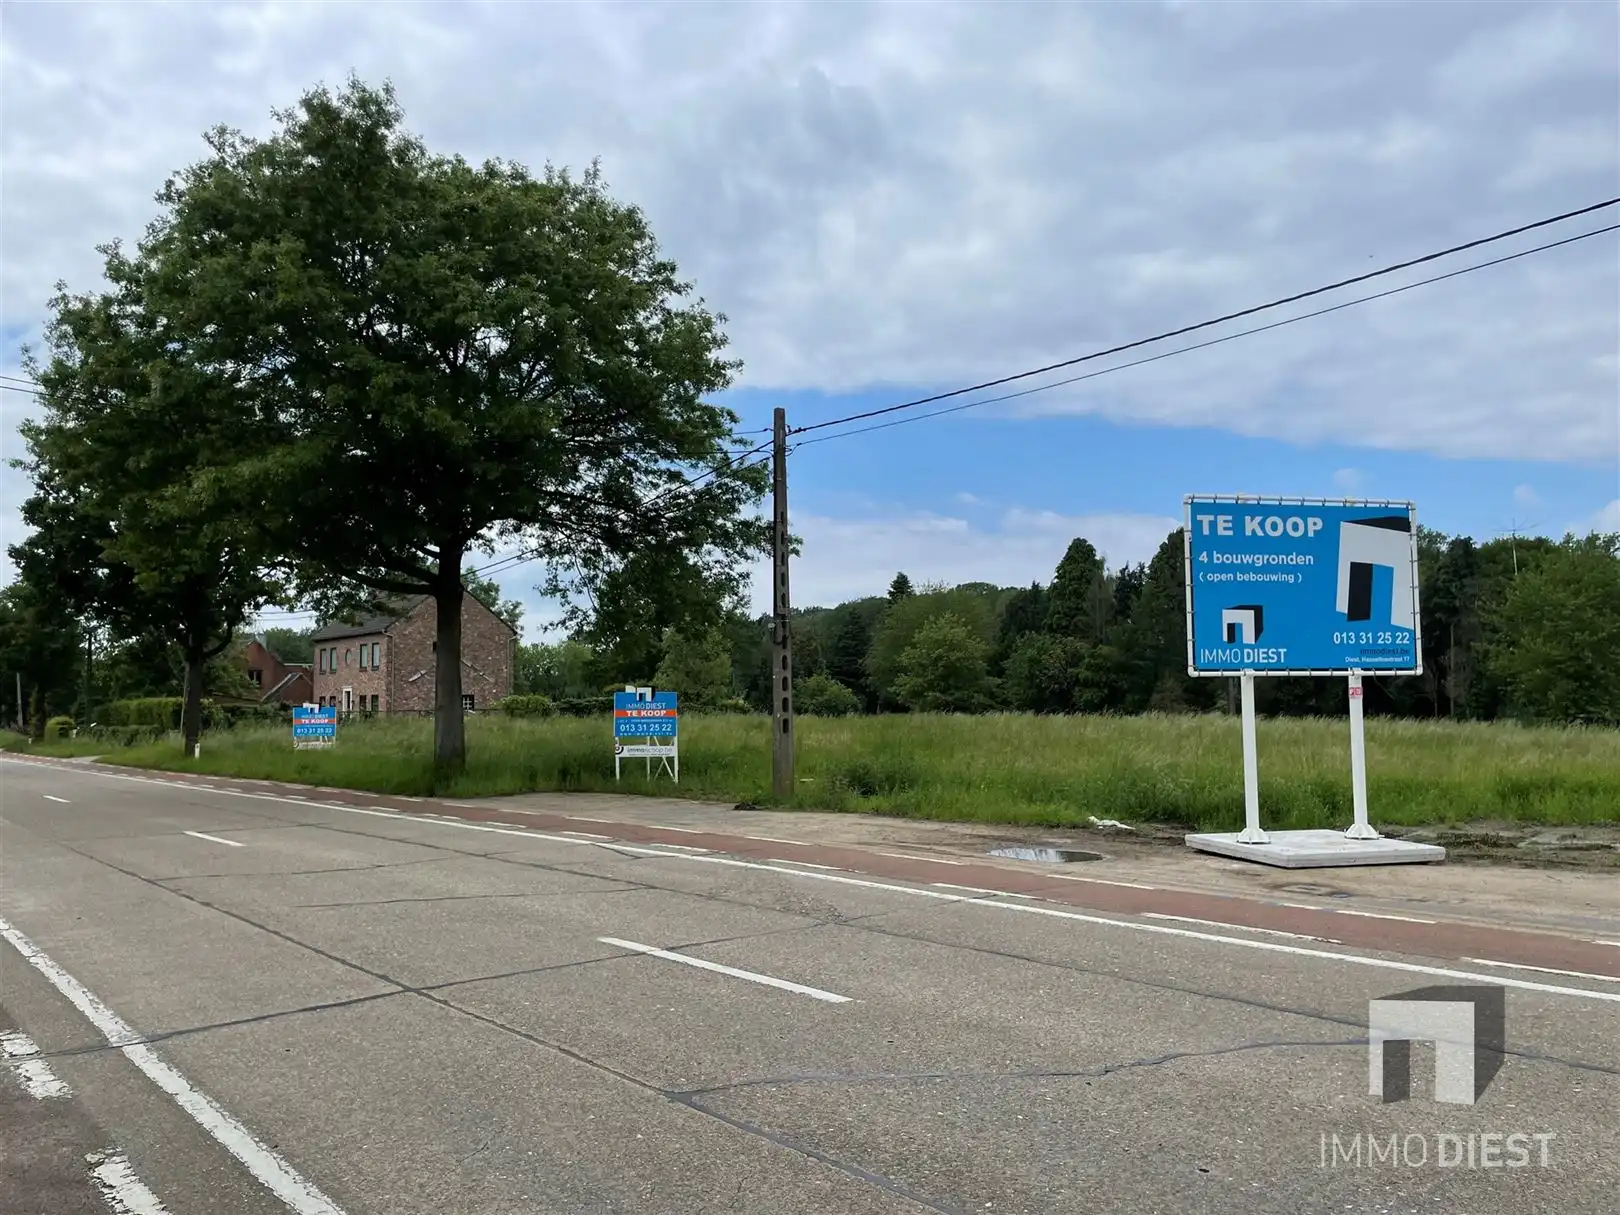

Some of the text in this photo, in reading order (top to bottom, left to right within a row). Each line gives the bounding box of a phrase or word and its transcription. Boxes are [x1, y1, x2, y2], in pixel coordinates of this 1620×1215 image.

[1196, 515, 1323, 537] TE KOOP
[1198, 551, 1314, 566] 4 bouwgronden
[1206, 573, 1234, 581] open
[1236, 572, 1295, 583] bebouwing
[1333, 632, 1410, 644] 013 31 25 22
[1200, 648, 1287, 663] IMMO DIEST
[620, 724, 672, 732] 013 31 25 22
